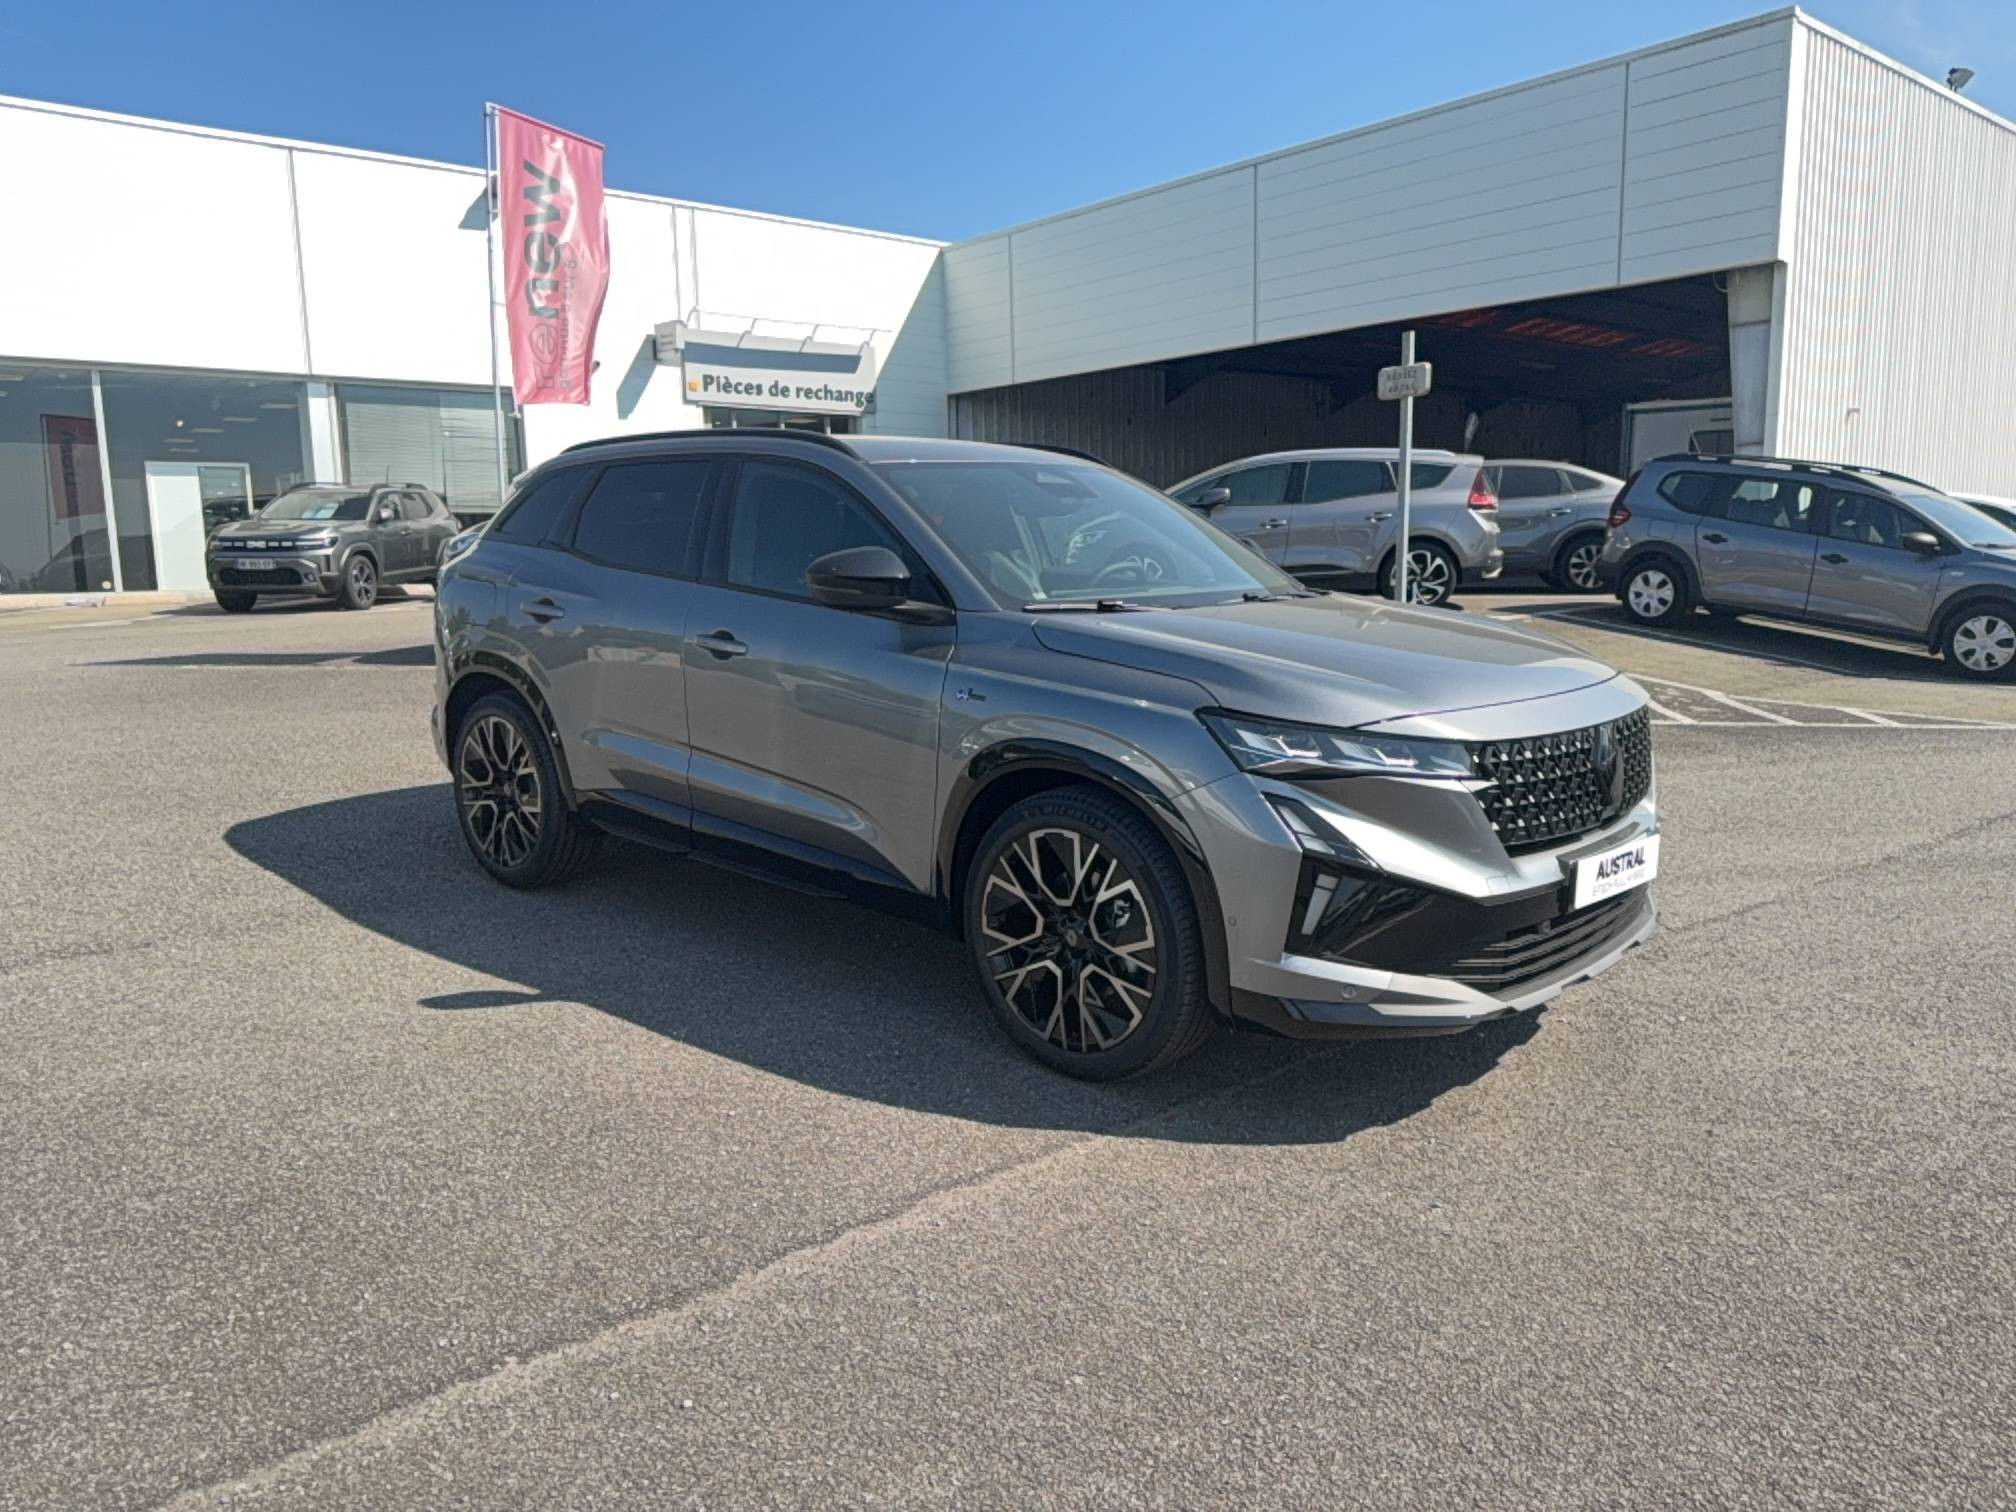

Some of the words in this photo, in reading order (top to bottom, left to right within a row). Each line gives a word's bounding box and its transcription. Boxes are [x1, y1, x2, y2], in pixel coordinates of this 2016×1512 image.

[523, 158, 561, 389] renew
[702, 374, 763, 395] Pièces
[768, 380, 791, 398] de
[795, 384, 874, 408] rechange
[1596, 847, 1645, 880] AUSTRAL
